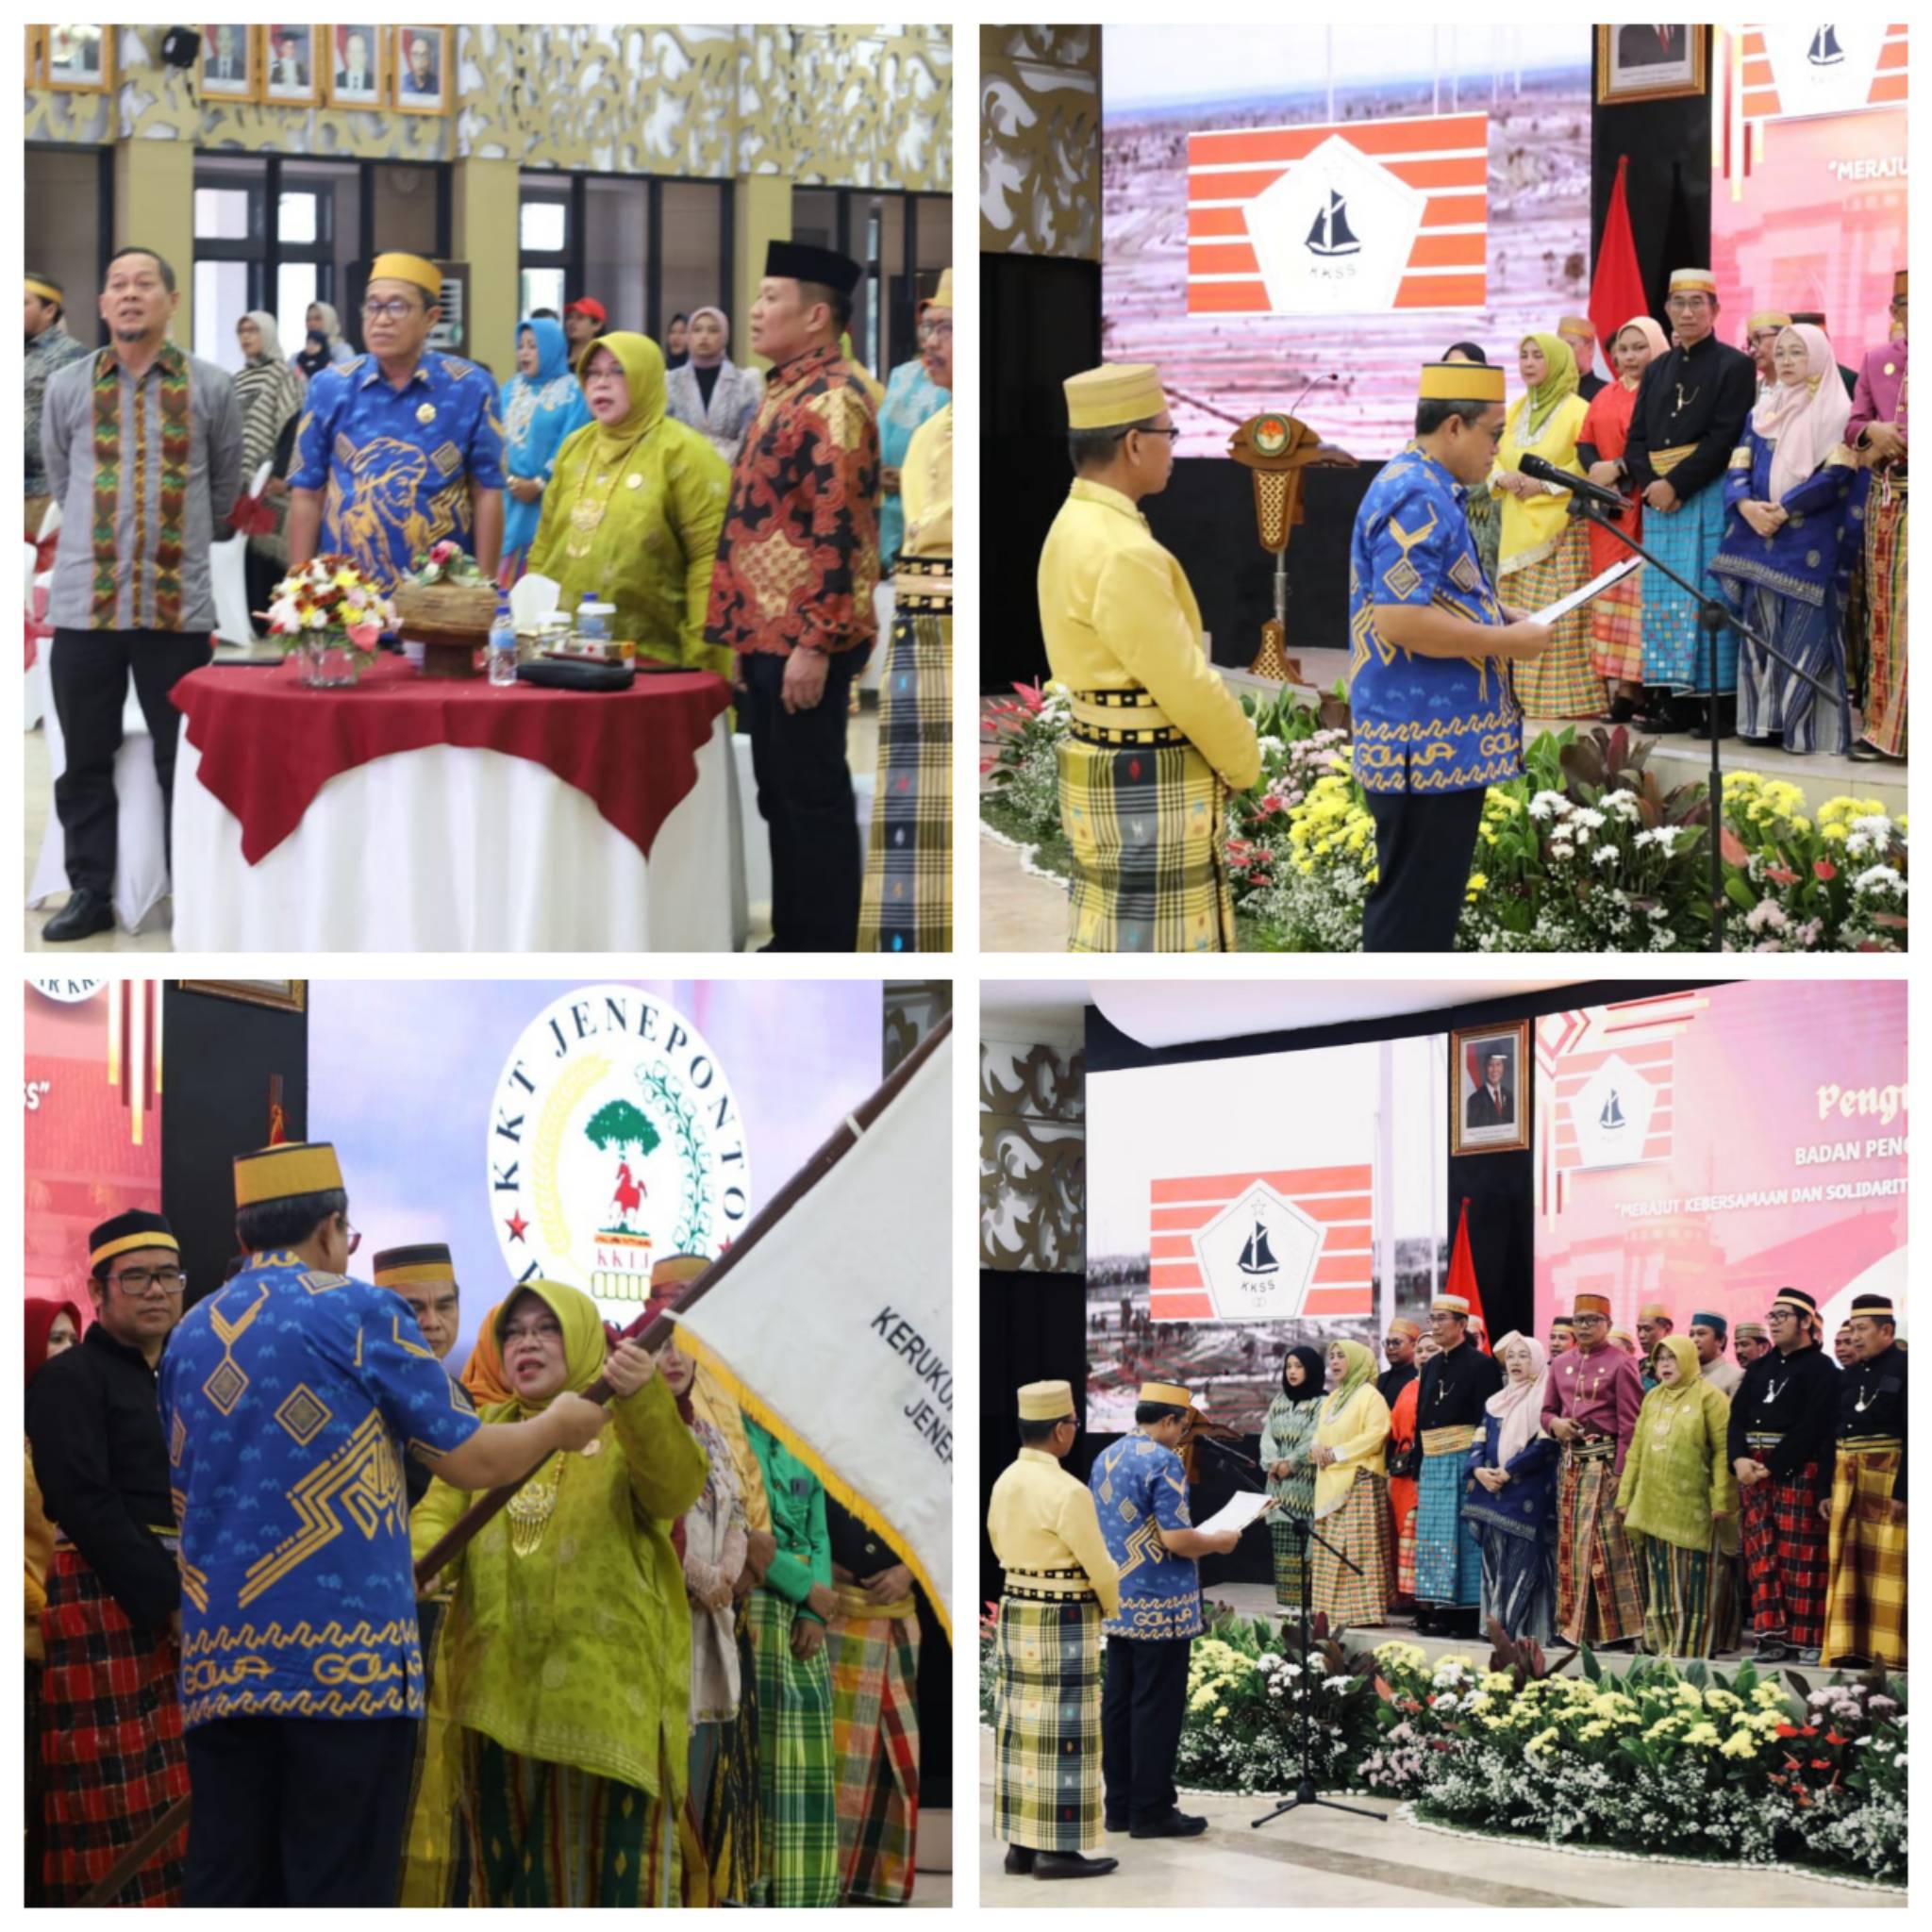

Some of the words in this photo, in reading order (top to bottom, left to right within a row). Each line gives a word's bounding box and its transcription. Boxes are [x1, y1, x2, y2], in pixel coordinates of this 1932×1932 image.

[493, 1059, 537, 1192] KKT
[547, 996, 746, 1221] JENEPONTO
[1794, 1141, 1861, 1166] BADAN
[1685, 1189, 1789, 1213] KEBERSAMAAN
[1792, 1185, 1824, 1204] DAN
[1241, 1279, 1275, 1293] KKSS
